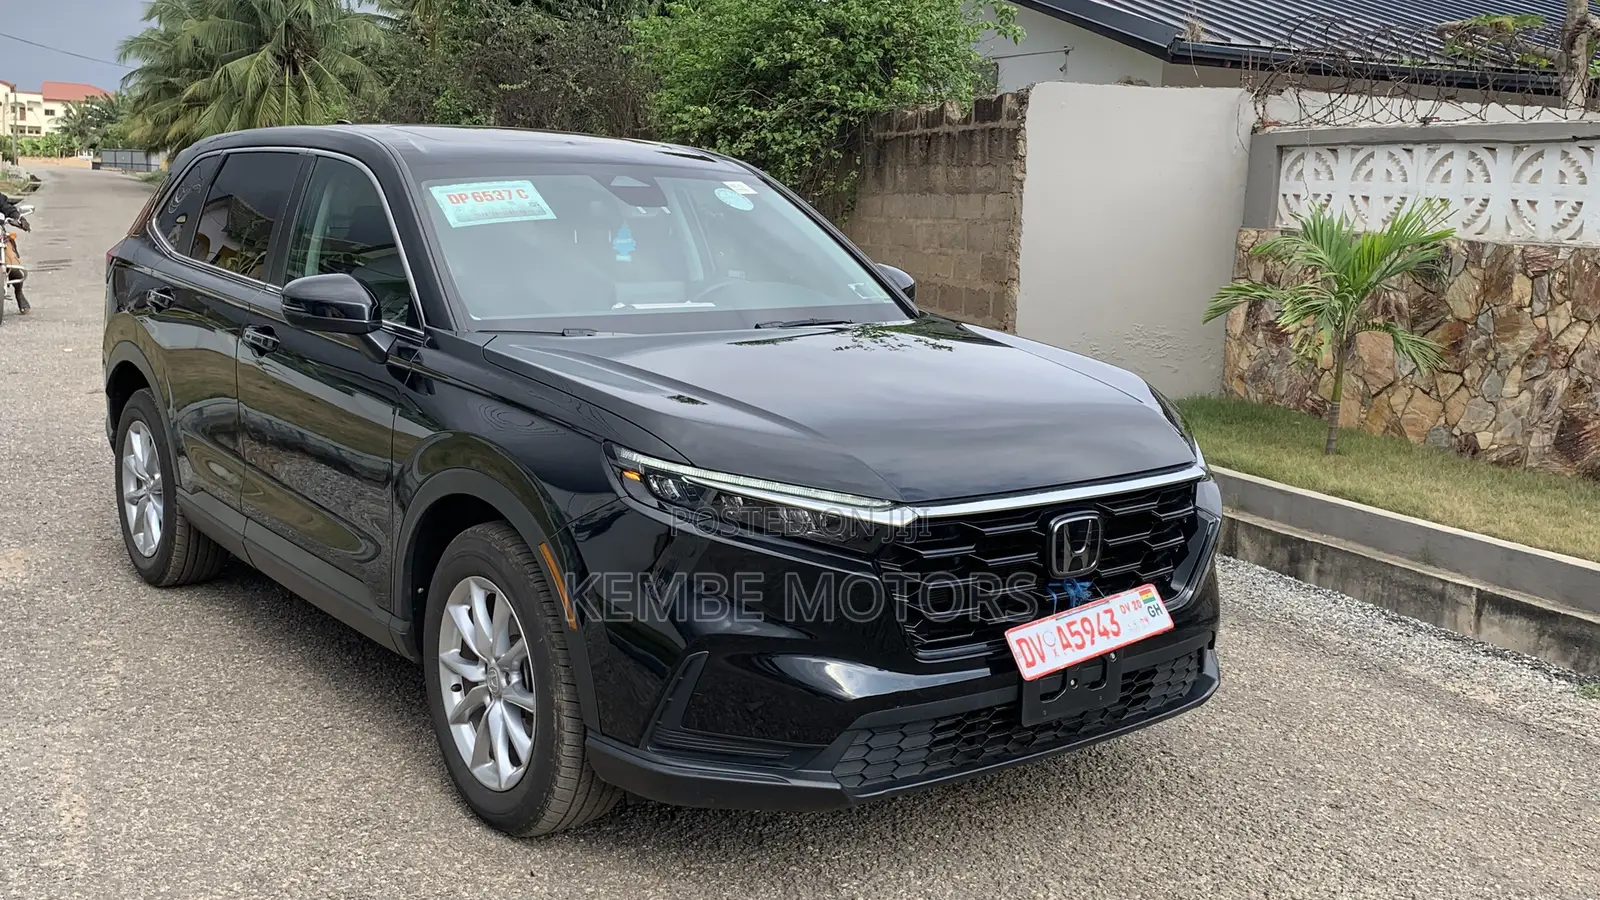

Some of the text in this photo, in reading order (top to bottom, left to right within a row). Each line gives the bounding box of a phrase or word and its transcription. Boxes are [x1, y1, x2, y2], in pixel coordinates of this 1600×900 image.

[446, 189, 530, 205] DP 6537 C
[1119, 599, 1143, 614] DV 20
[1147, 603, 1164, 618] GH
[1015, 607, 1122, 669] DV A5943
